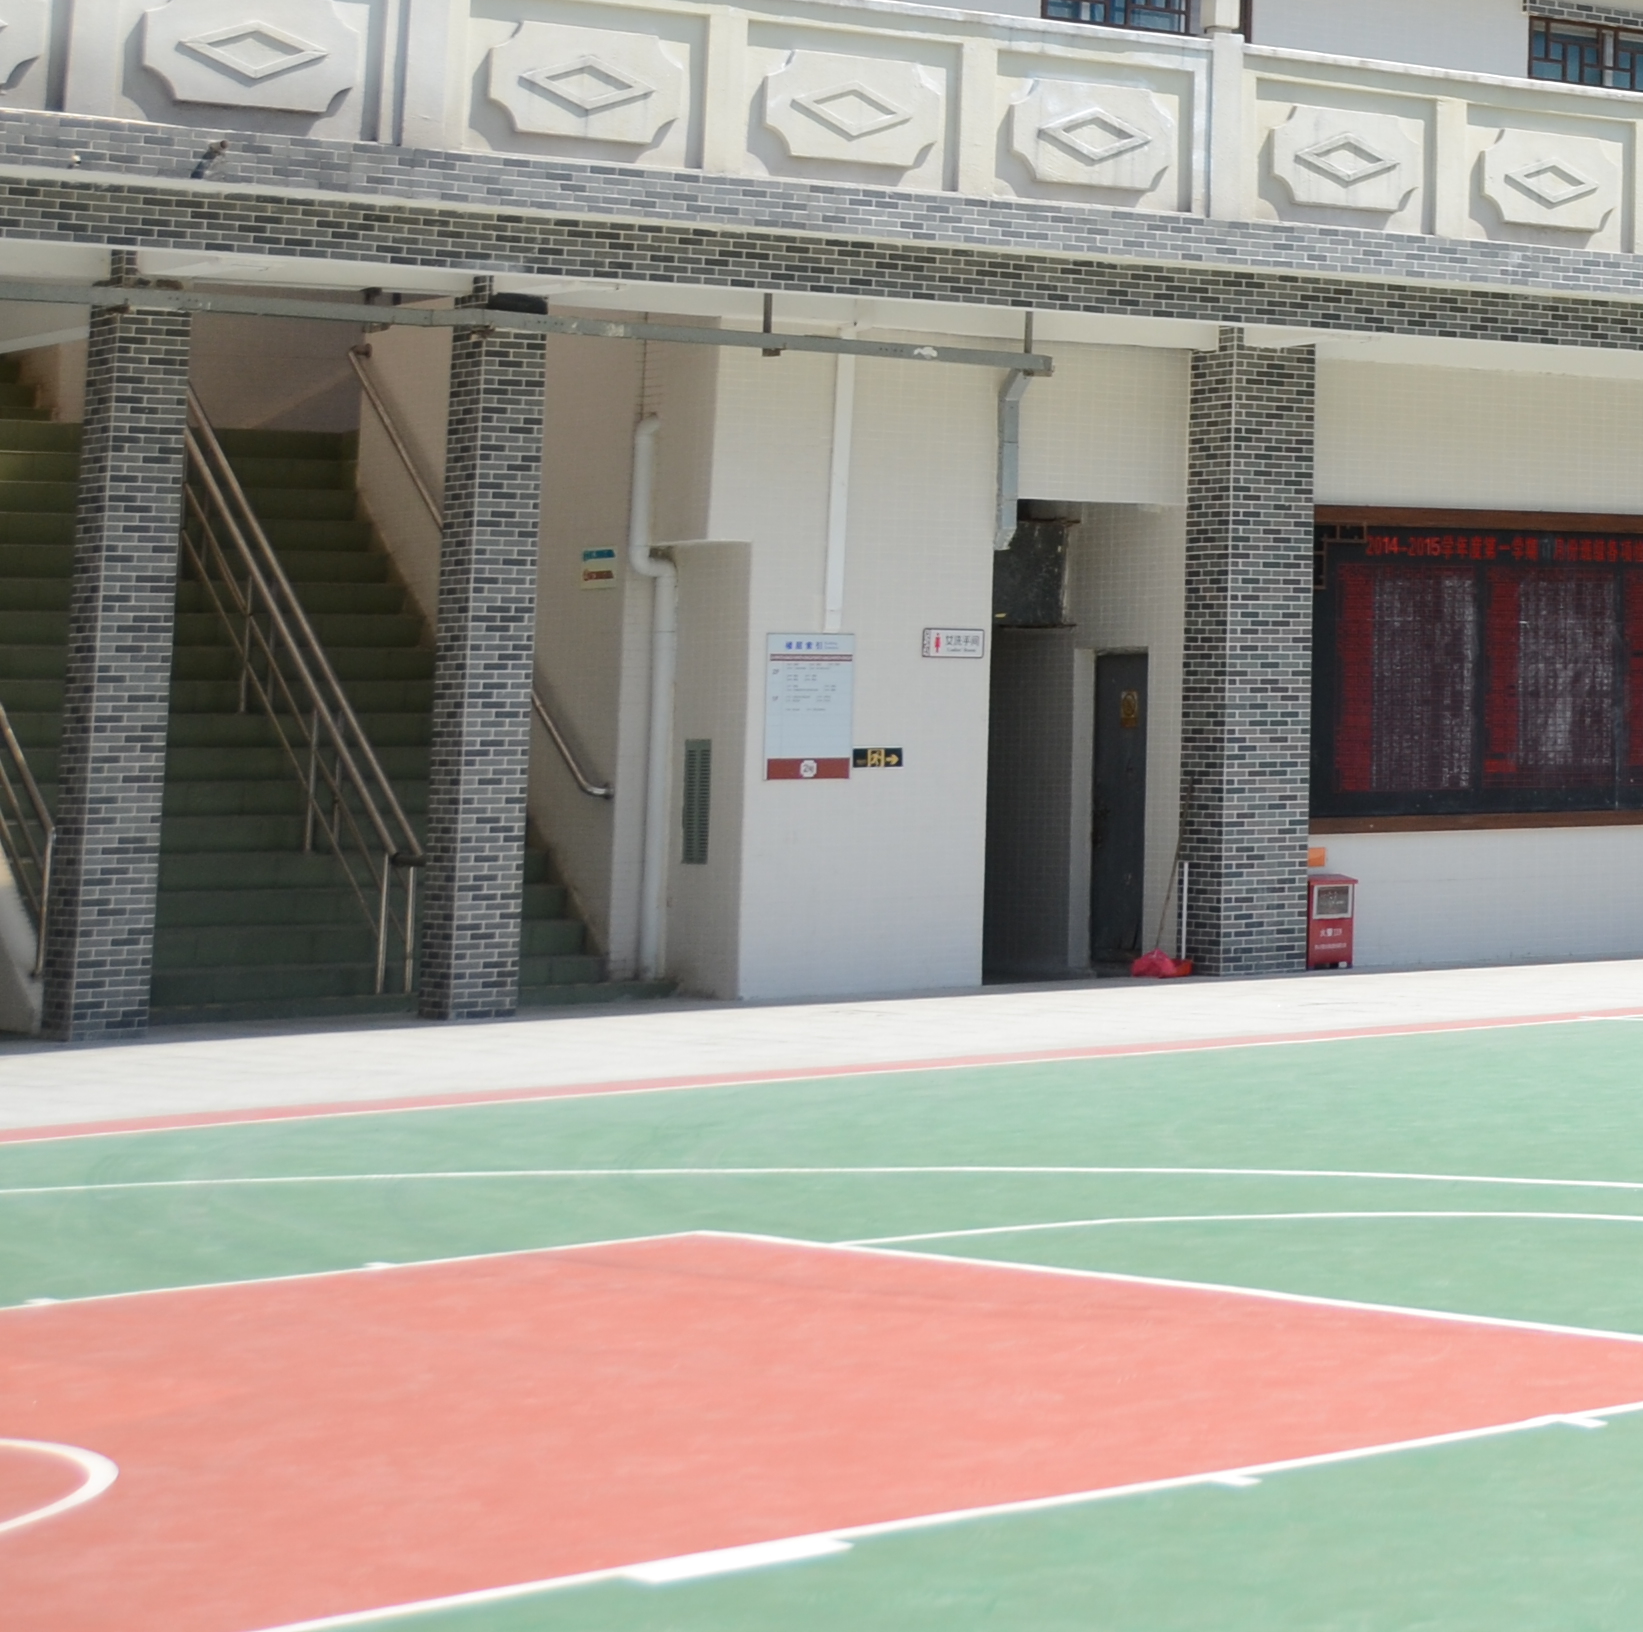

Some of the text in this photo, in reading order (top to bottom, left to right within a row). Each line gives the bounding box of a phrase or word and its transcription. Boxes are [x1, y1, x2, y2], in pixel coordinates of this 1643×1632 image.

[785, 640, 823, 650] 楼层索引
[945, 635, 980, 647] 女洗手间
